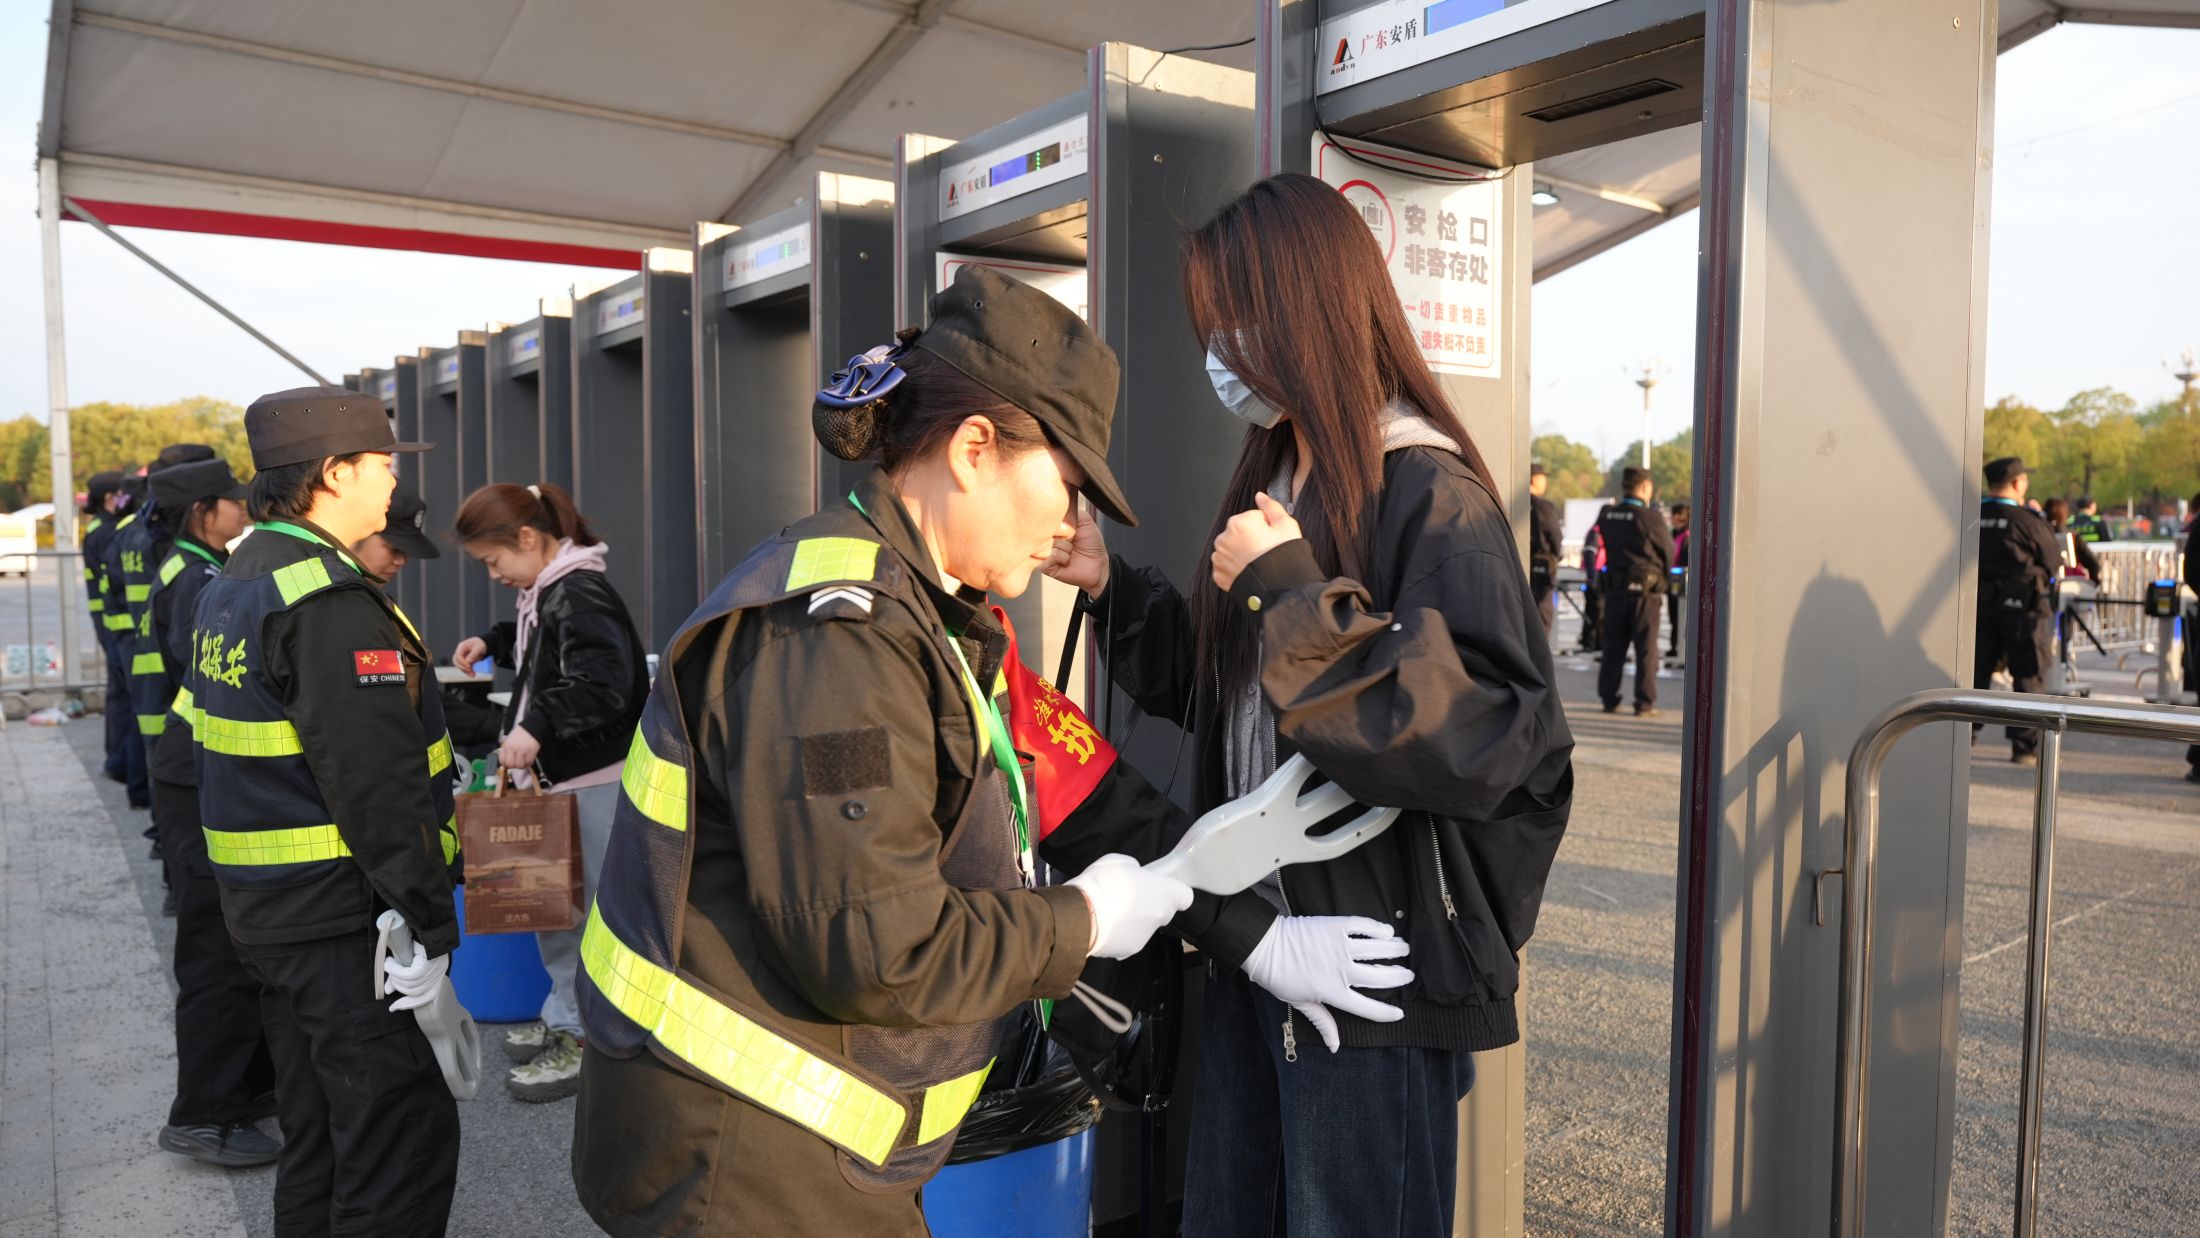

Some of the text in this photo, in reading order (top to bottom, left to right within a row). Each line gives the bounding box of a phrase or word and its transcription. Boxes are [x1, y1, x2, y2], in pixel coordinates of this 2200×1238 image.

[1361, 18, 1417, 56] 广东安盾
[1405, 204, 1488, 247] 安检口
[1405, 243, 1489, 286] 非寄存处
[360, 675, 379, 684] 保安
[489, 824, 543, 843] FADAJE
